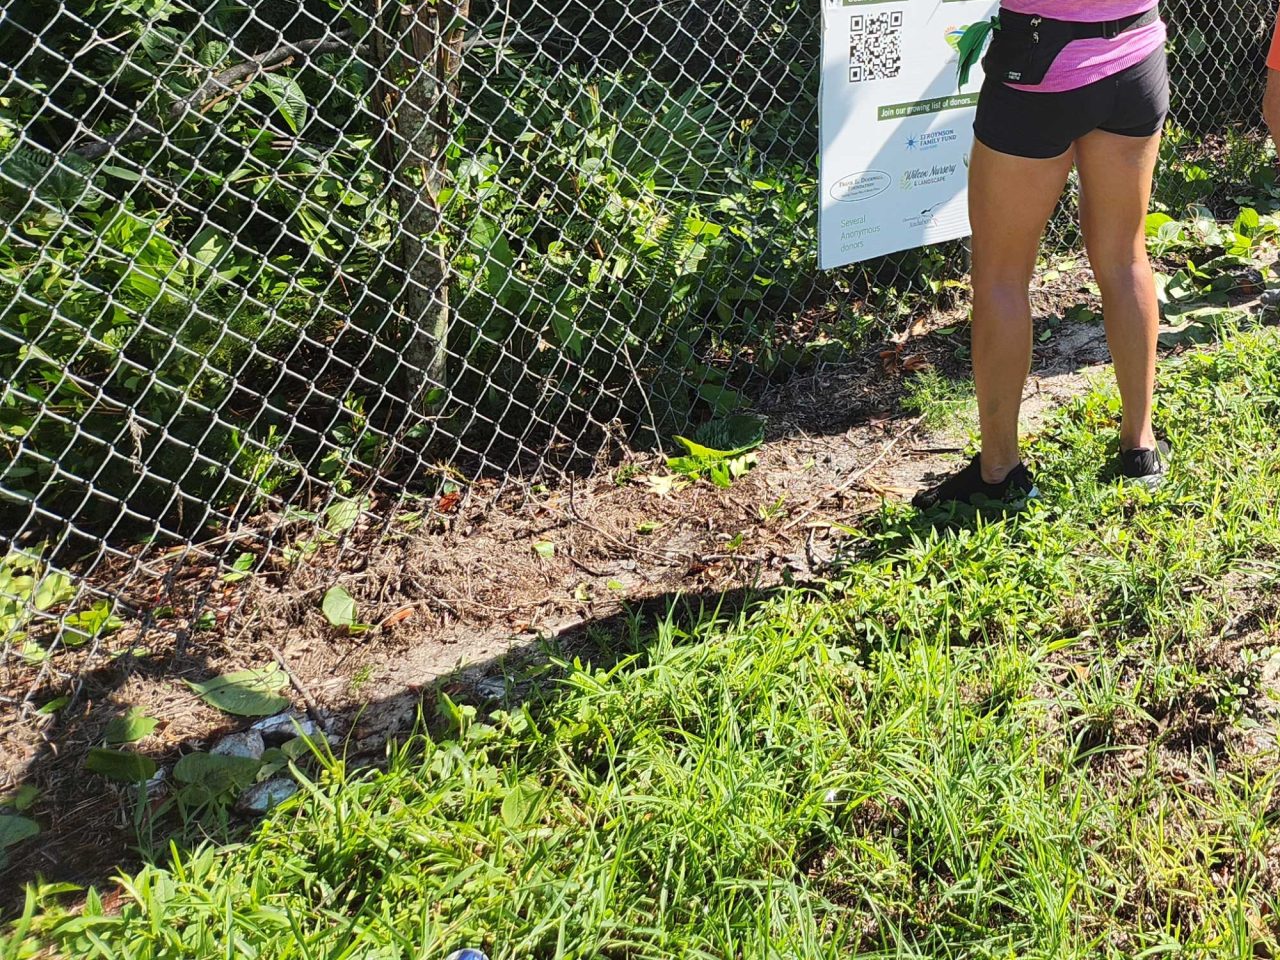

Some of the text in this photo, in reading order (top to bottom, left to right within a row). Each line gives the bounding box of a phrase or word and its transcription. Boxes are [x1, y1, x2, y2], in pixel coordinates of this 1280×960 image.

[881, 107, 894, 118] Join
[896, 106, 906, 115] our
[907, 103, 930, 115] growing
[932, 101, 940, 110] list
[841, 215, 866, 228] Several
[840, 226, 880, 240] Anonymous
[840, 242, 864, 253] donors
